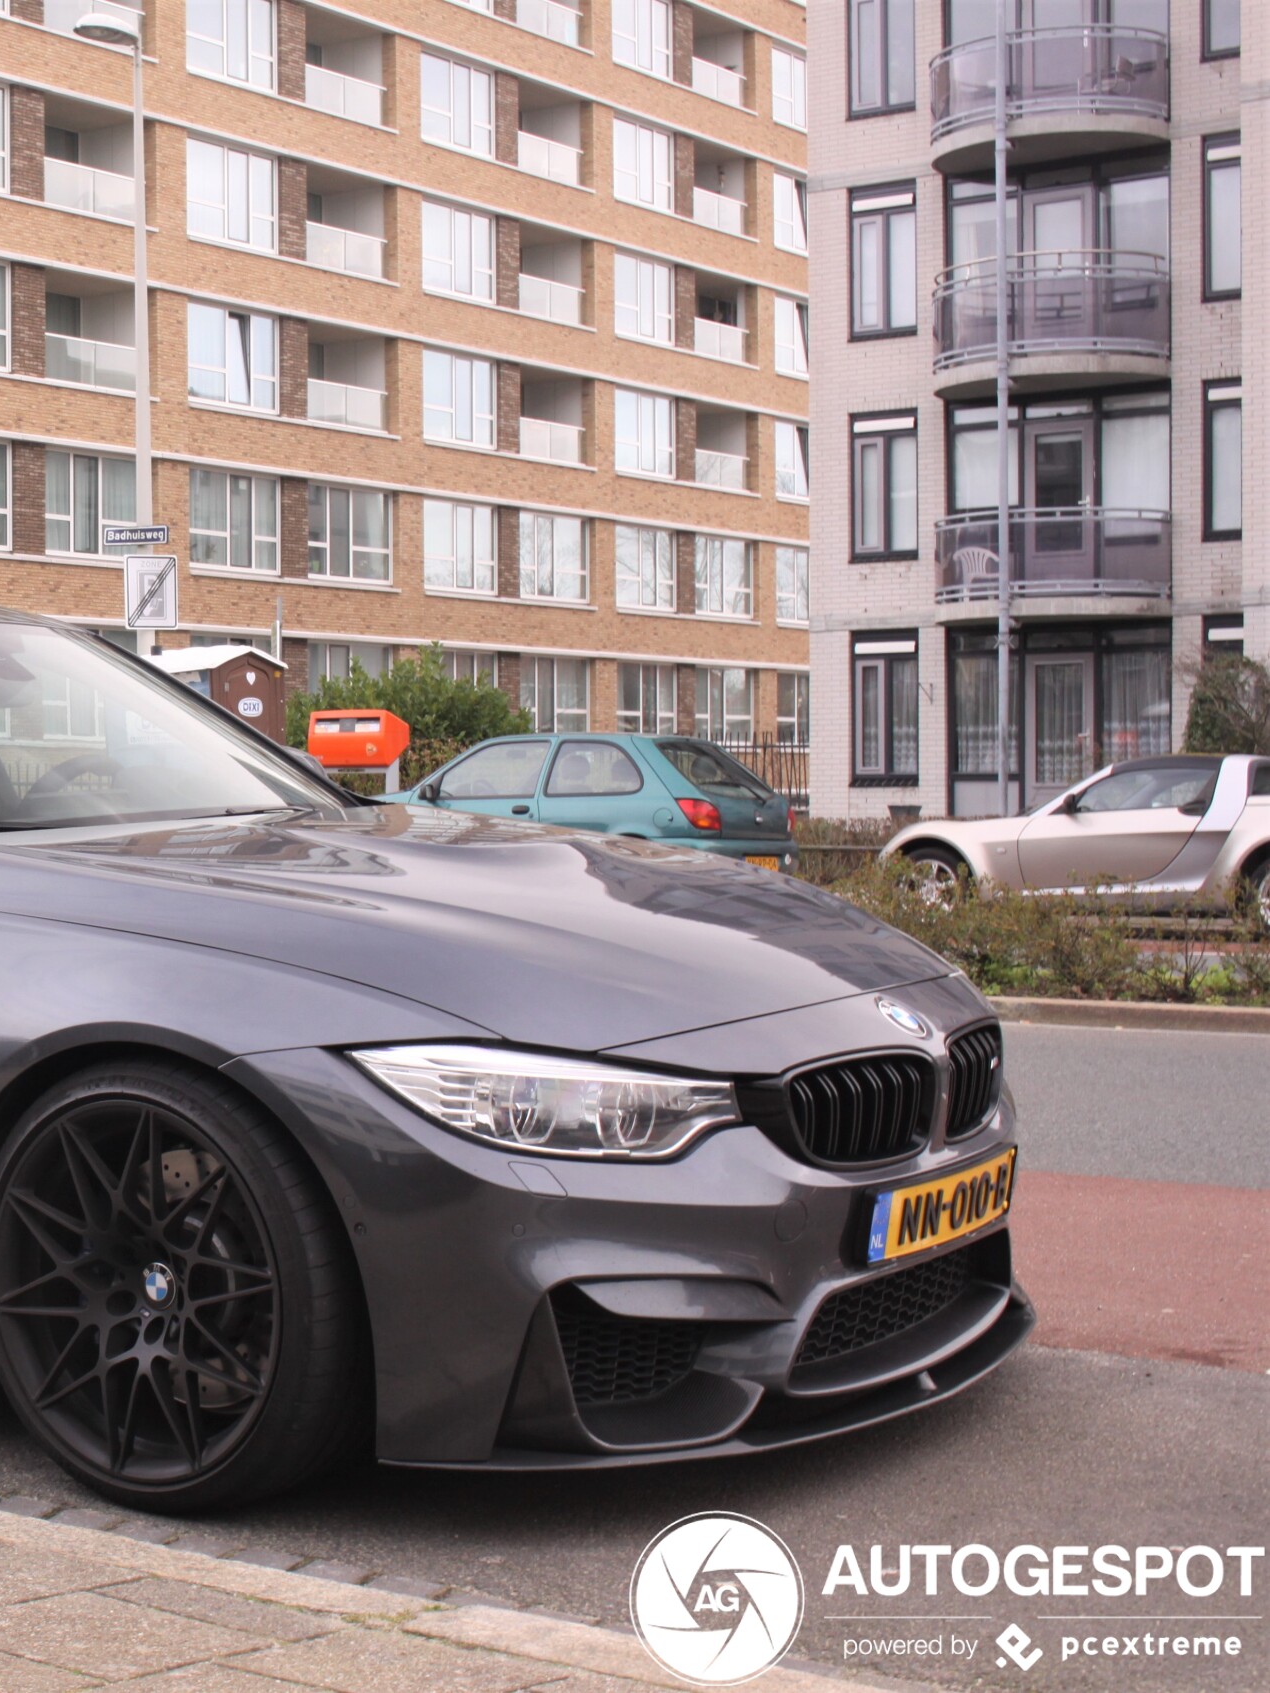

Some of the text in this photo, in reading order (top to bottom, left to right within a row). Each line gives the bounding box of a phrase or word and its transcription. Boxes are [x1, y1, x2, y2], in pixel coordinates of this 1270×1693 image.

[107, 530, 164, 541] Badhuisweg
[140, 560, 163, 568] ZONE
[243, 702, 260, 711] DIXI
[897, 1162, 1008, 1247] NN-010-B
[870, 1233, 884, 1248] NL
